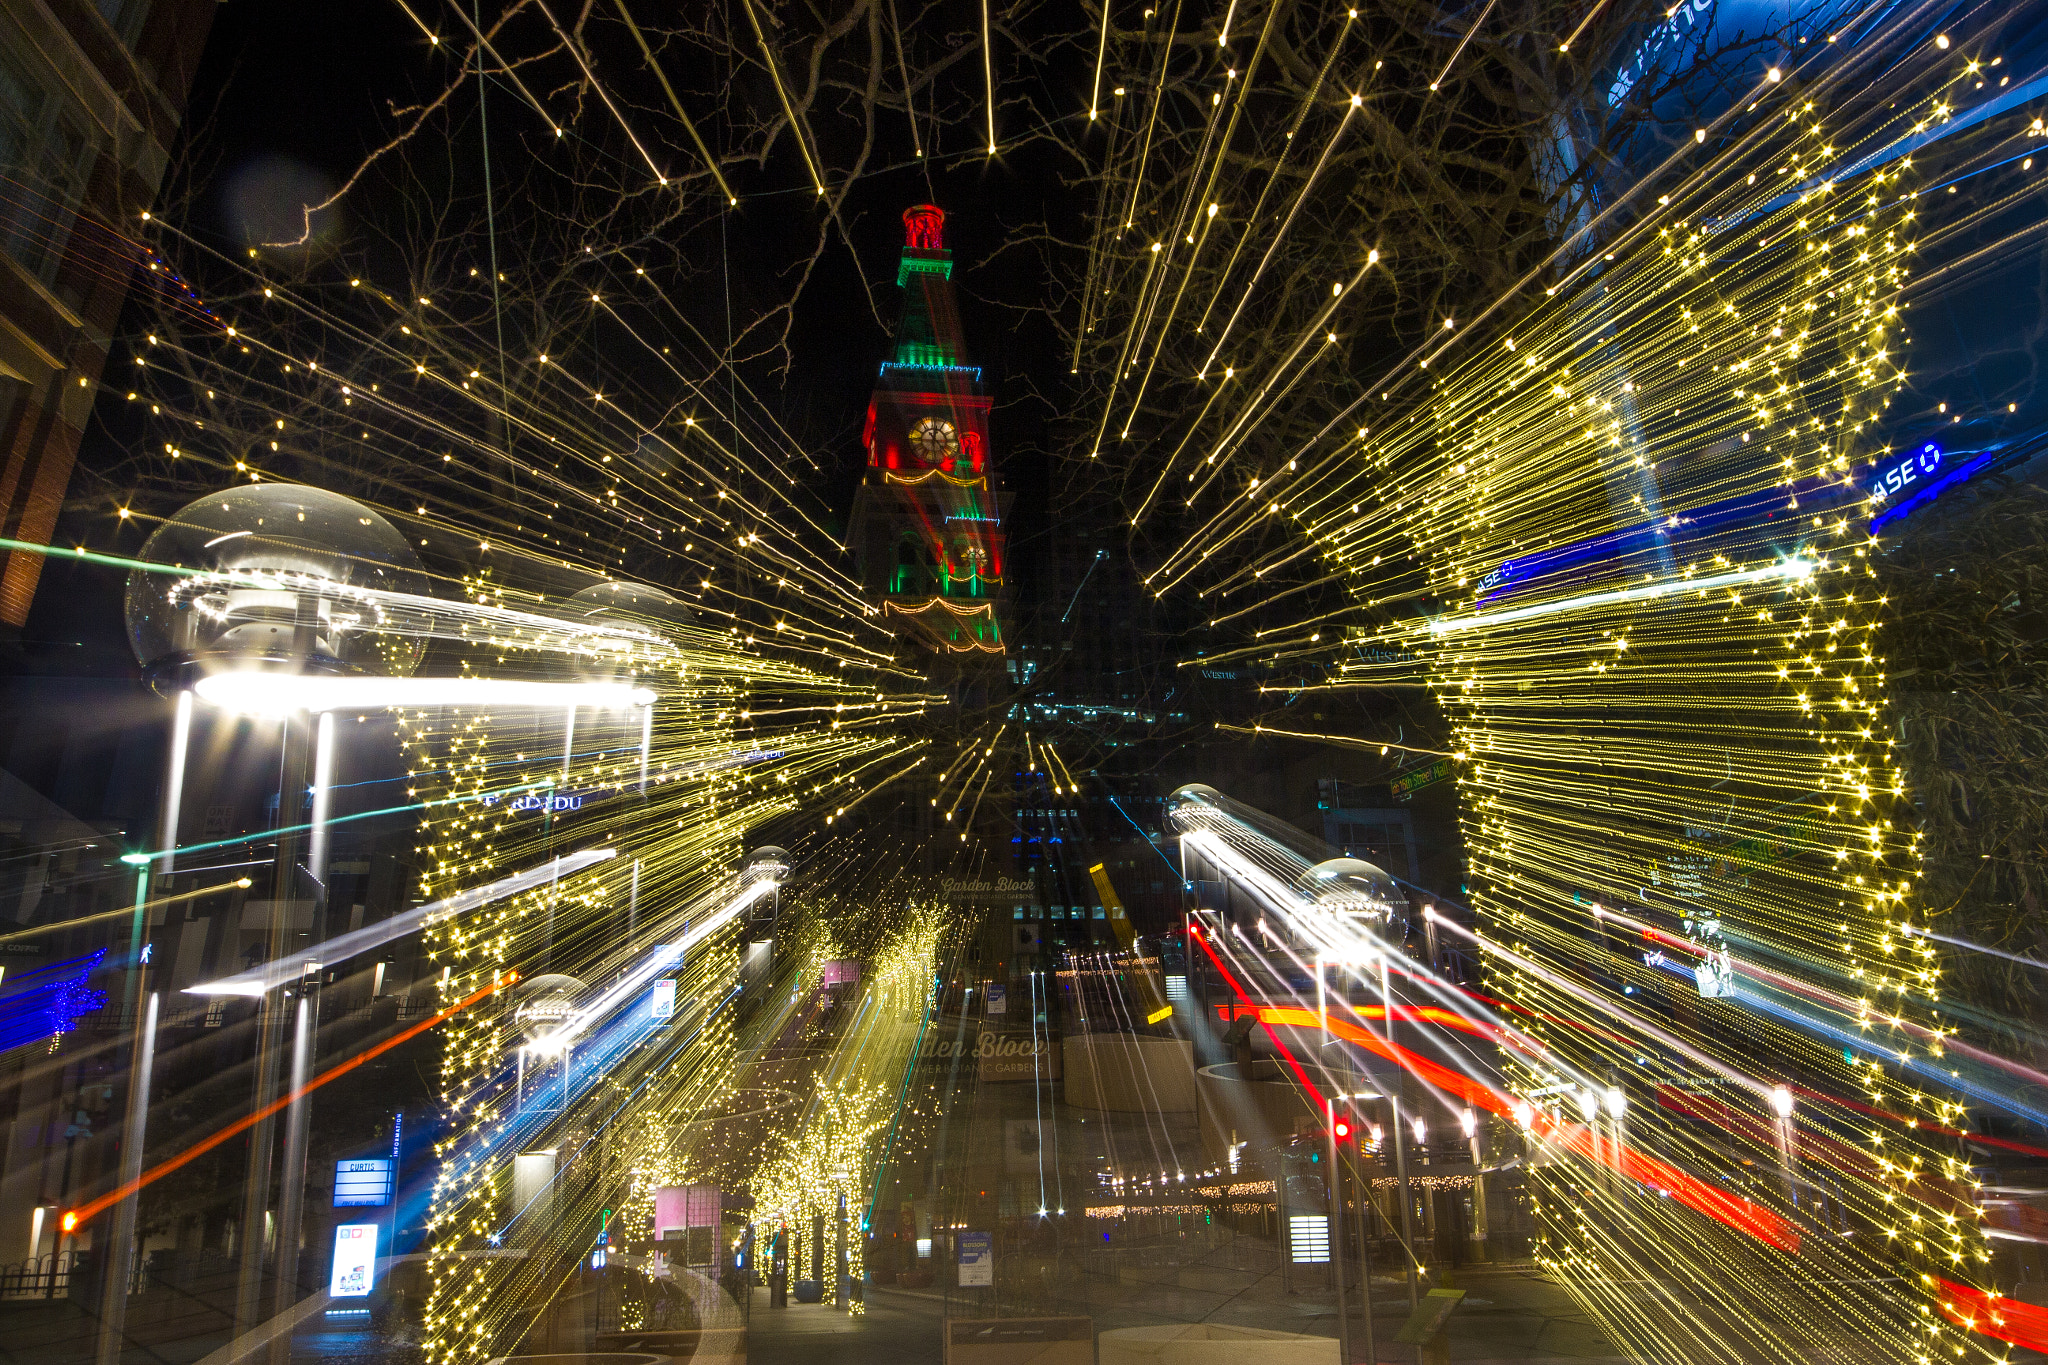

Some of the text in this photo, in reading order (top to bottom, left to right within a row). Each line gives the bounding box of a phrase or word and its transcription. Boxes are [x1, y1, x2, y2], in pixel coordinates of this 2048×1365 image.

[209, 807, 233, 817] ONE
[206, 817, 231, 827] WAY
[941, 876, 1036, 900] Garden Block
[972, 1031, 1051, 1059] Block
[995, 1062, 1044, 1073] GARDENS
[393, 1113, 402, 1157] INFORMATION
[350, 1162, 375, 1172] CURTIS
